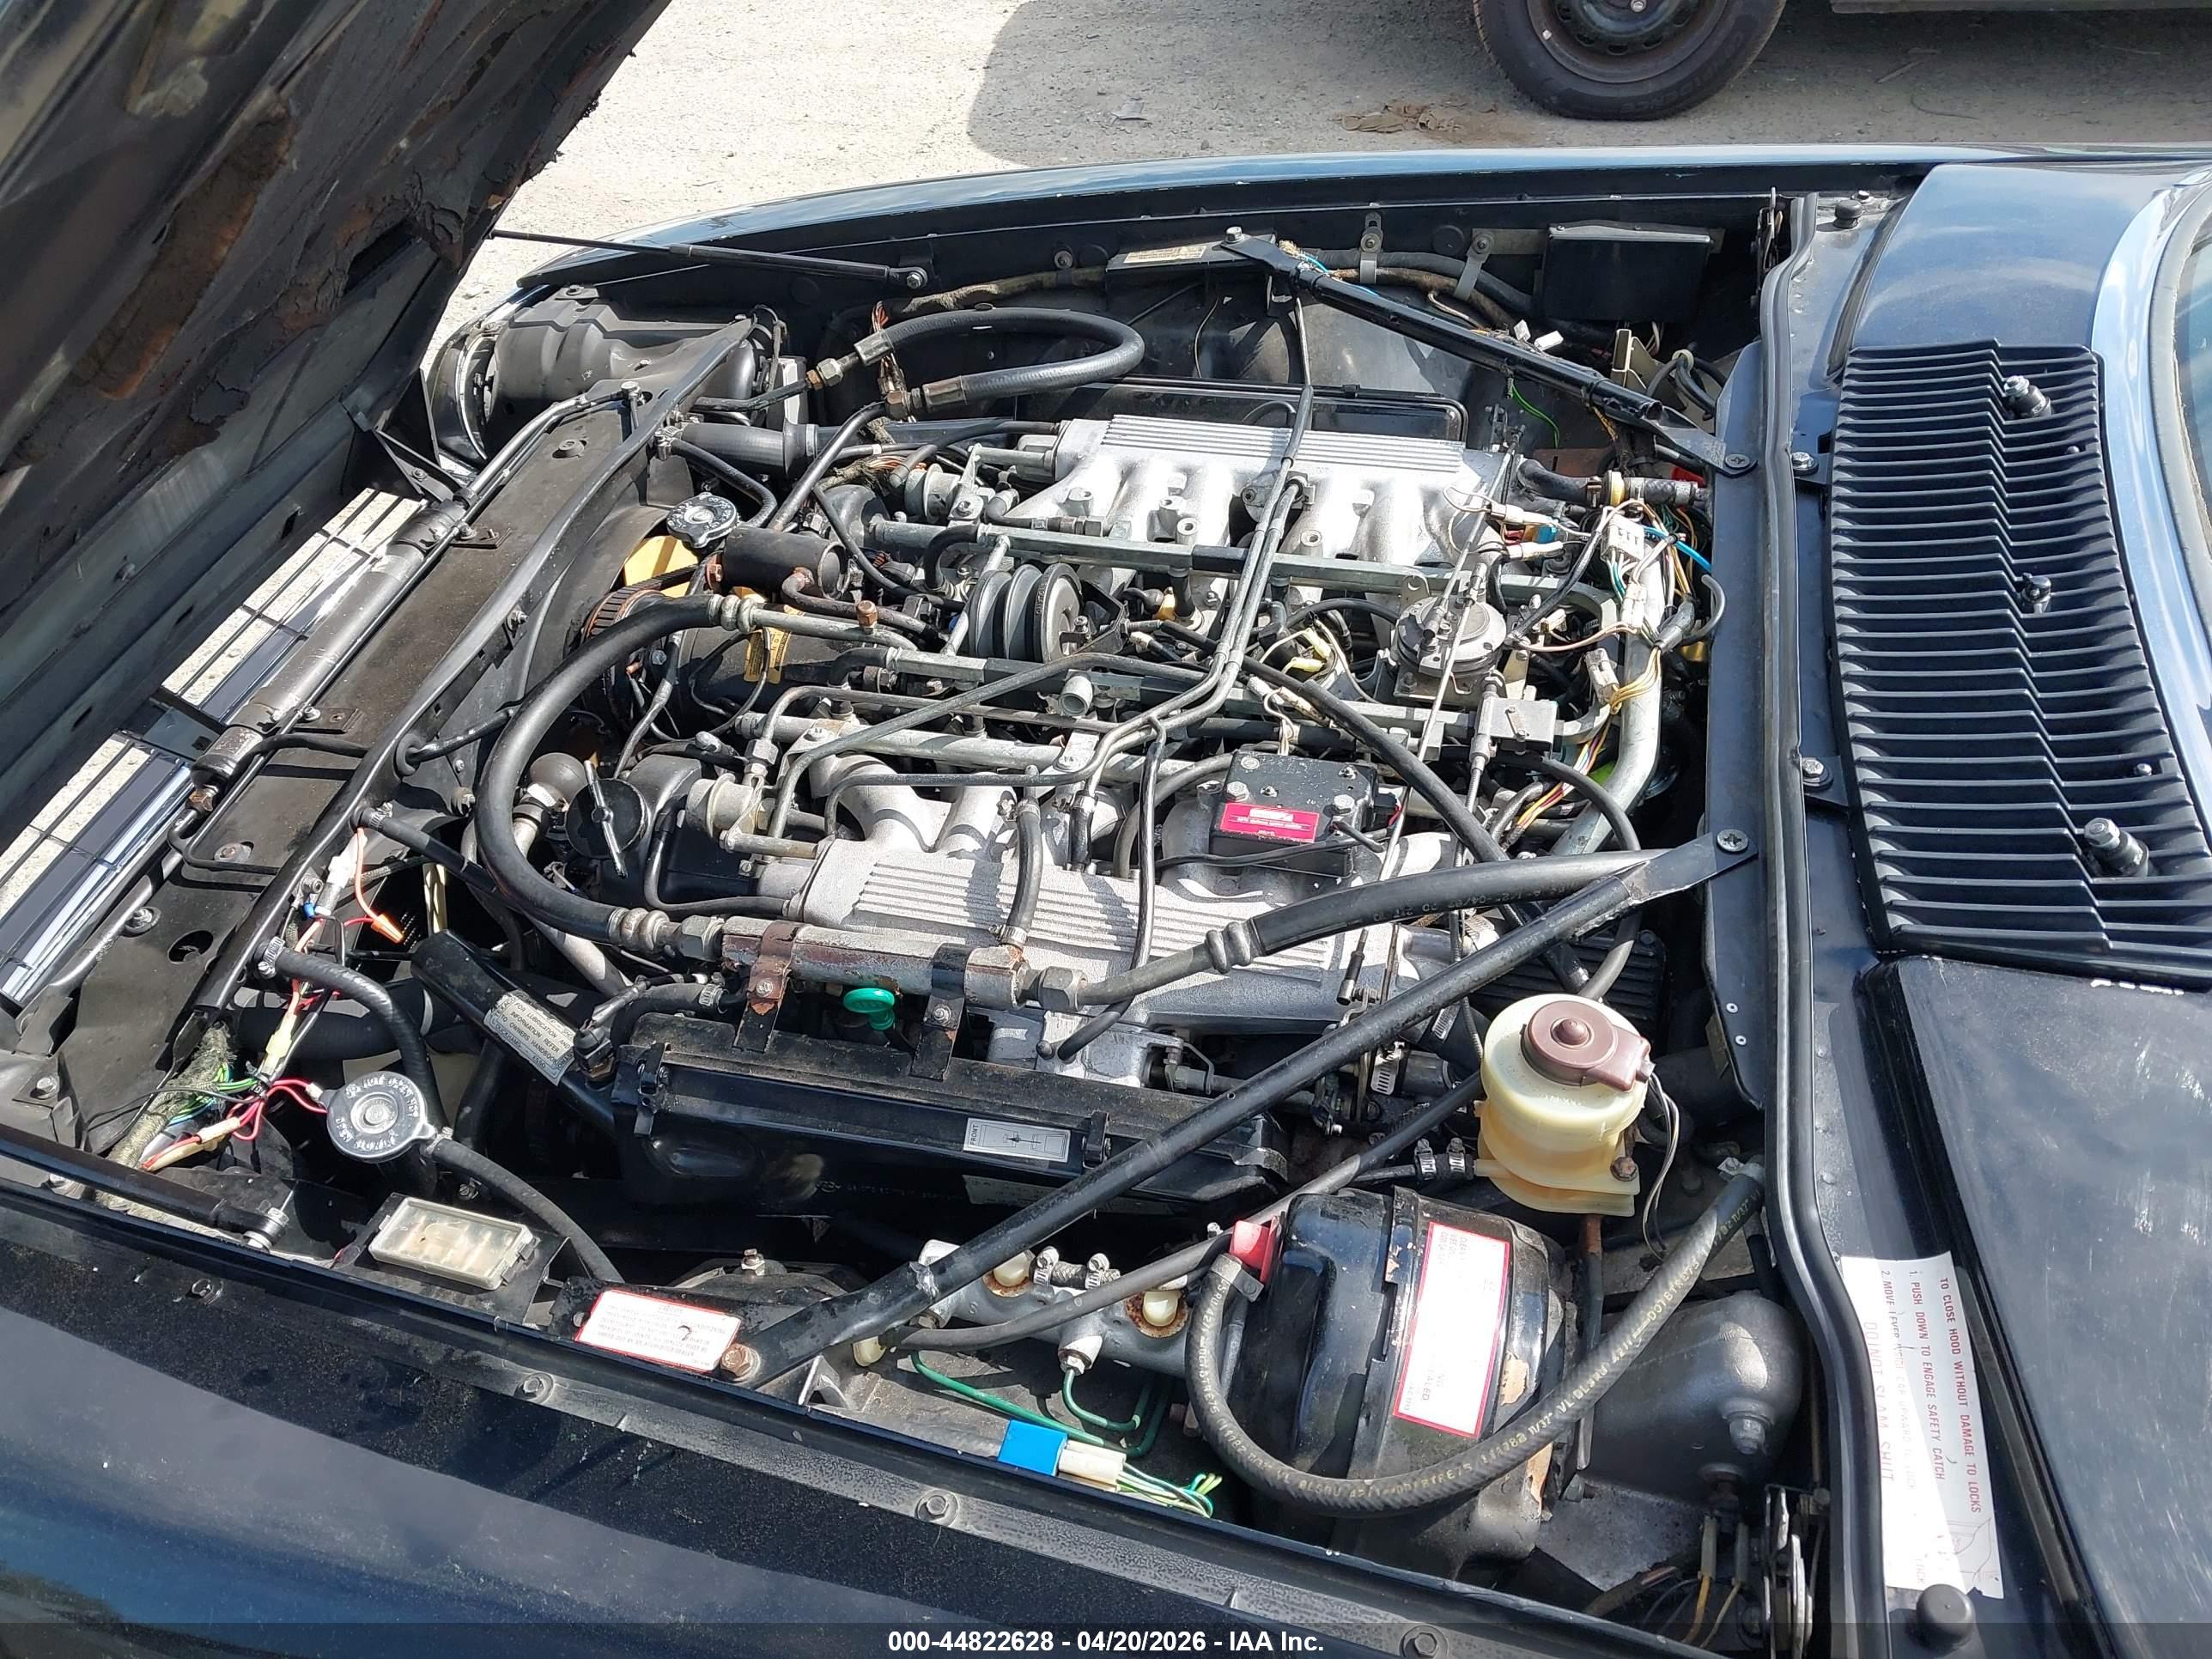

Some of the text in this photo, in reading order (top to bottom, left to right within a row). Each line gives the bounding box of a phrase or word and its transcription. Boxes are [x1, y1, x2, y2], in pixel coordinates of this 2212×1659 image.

[501, 1014, 558, 1065] TO OWNERS HANDBOOK
[510, 1012, 560, 1054] INFORMATION REFER
[514, 1002, 571, 1049] FOR LUBRICATION AND
[532, 1055, 546, 1069] ESSO
[969, 1124, 980, 1146] FRONT
[1882, 1279, 1897, 1306] MOVE
[1911, 1282, 1923, 1305] PUSH
[1915, 1311, 1929, 1340] DOWN
[1920, 1345, 1931, 1357] TO
[1922, 1361, 1936, 1399] ENGAGE
[1940, 1277, 1981, 1513] TO CLOSE HOOD WITHOUT DAMAGE TO LOCKS
[1556, 1395, 1575, 1413] VL
[1927, 1403, 1943, 1442] SAFETY
[1932, 1447, 1945, 1480] CATCH
